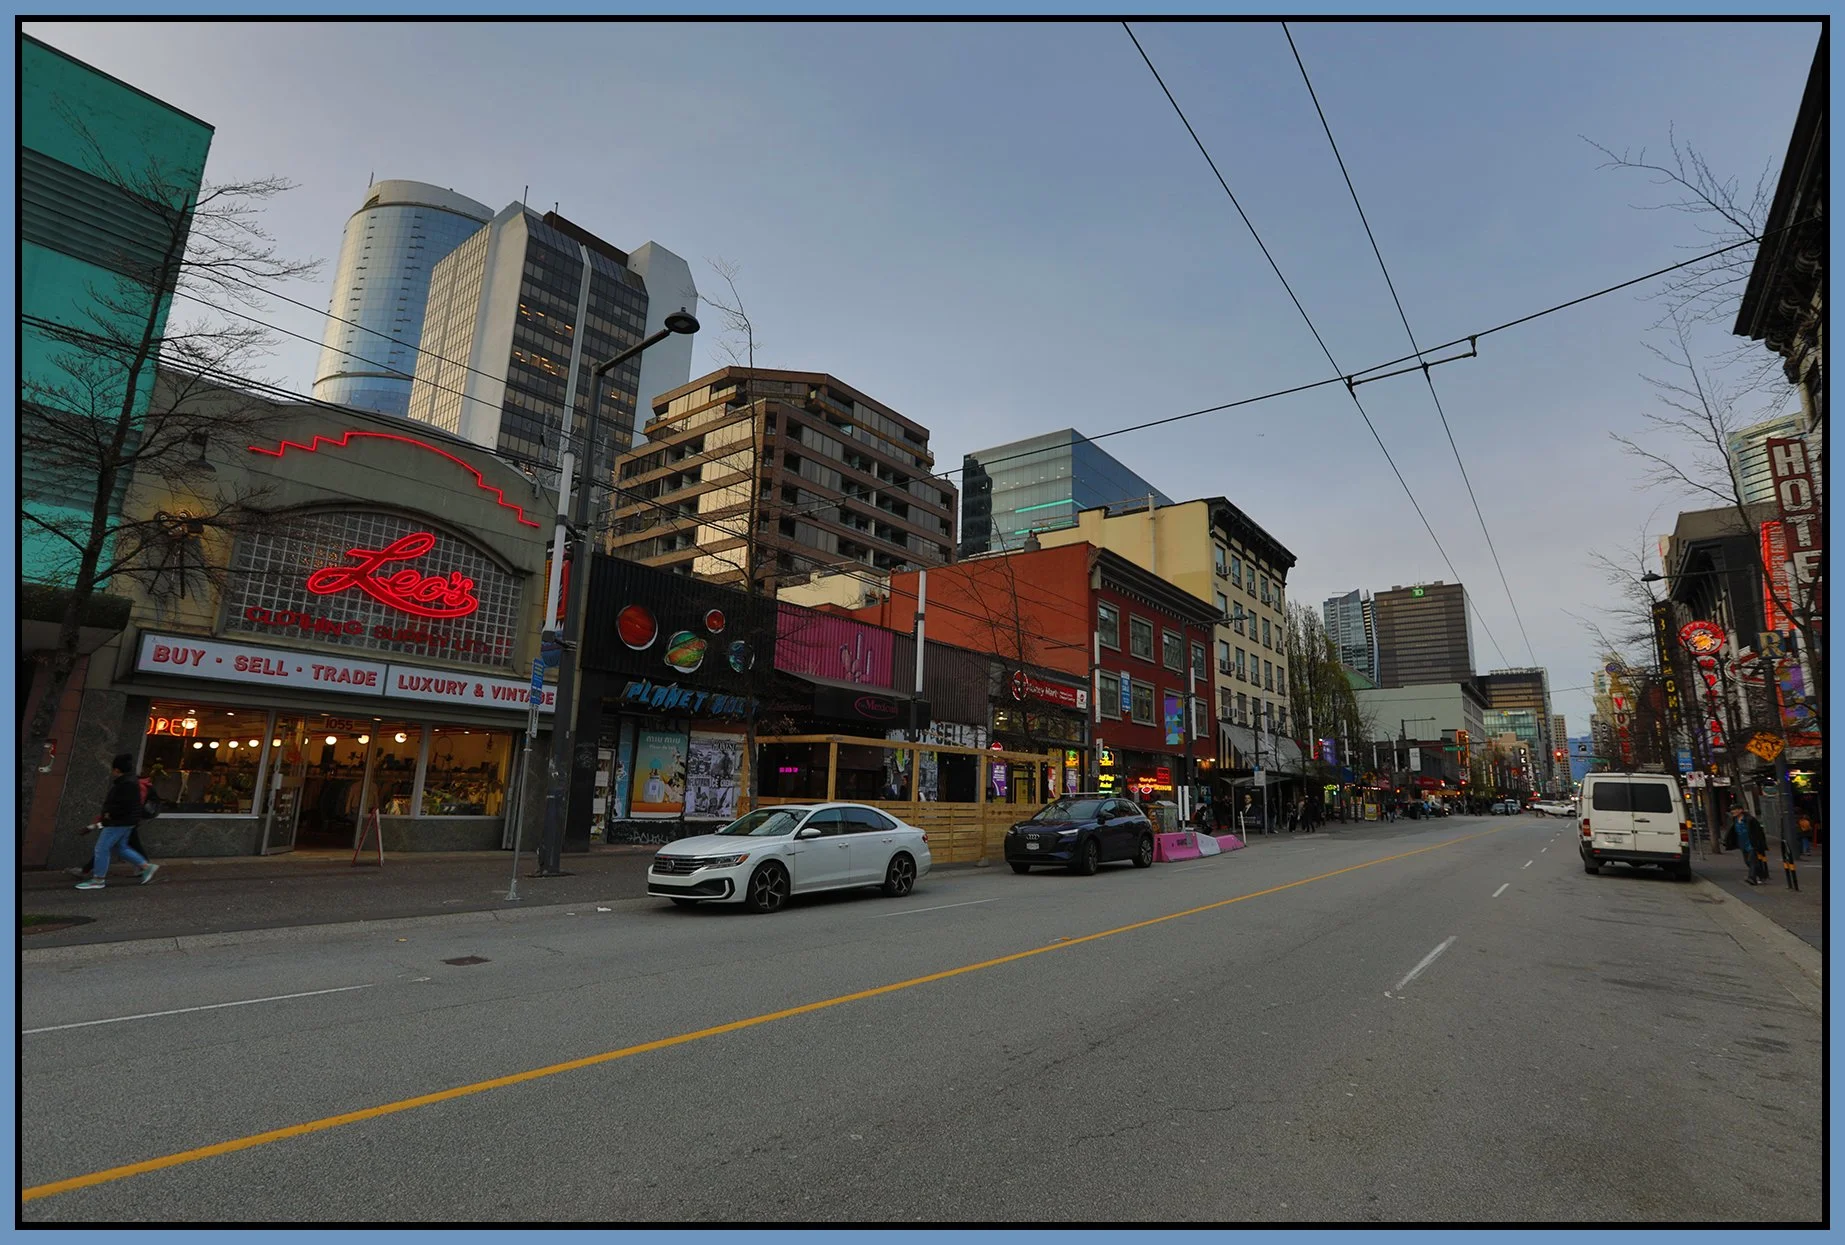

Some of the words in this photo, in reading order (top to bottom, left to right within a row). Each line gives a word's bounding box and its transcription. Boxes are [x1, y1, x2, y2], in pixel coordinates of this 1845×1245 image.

[1769, 525, 1785, 553] FAMILY
[306, 531, 479, 619] Leo's
[245, 606, 365, 637] CLOTHING
[152, 644, 207, 667] BUY
[234, 655, 289, 677] SELL
[312, 664, 378, 687] TRADE
[398, 674, 468, 697] LUXURY
[473, 683, 485, 698] &
[621, 679, 710, 713] PLANET
[325, 717, 354, 731] 1055
